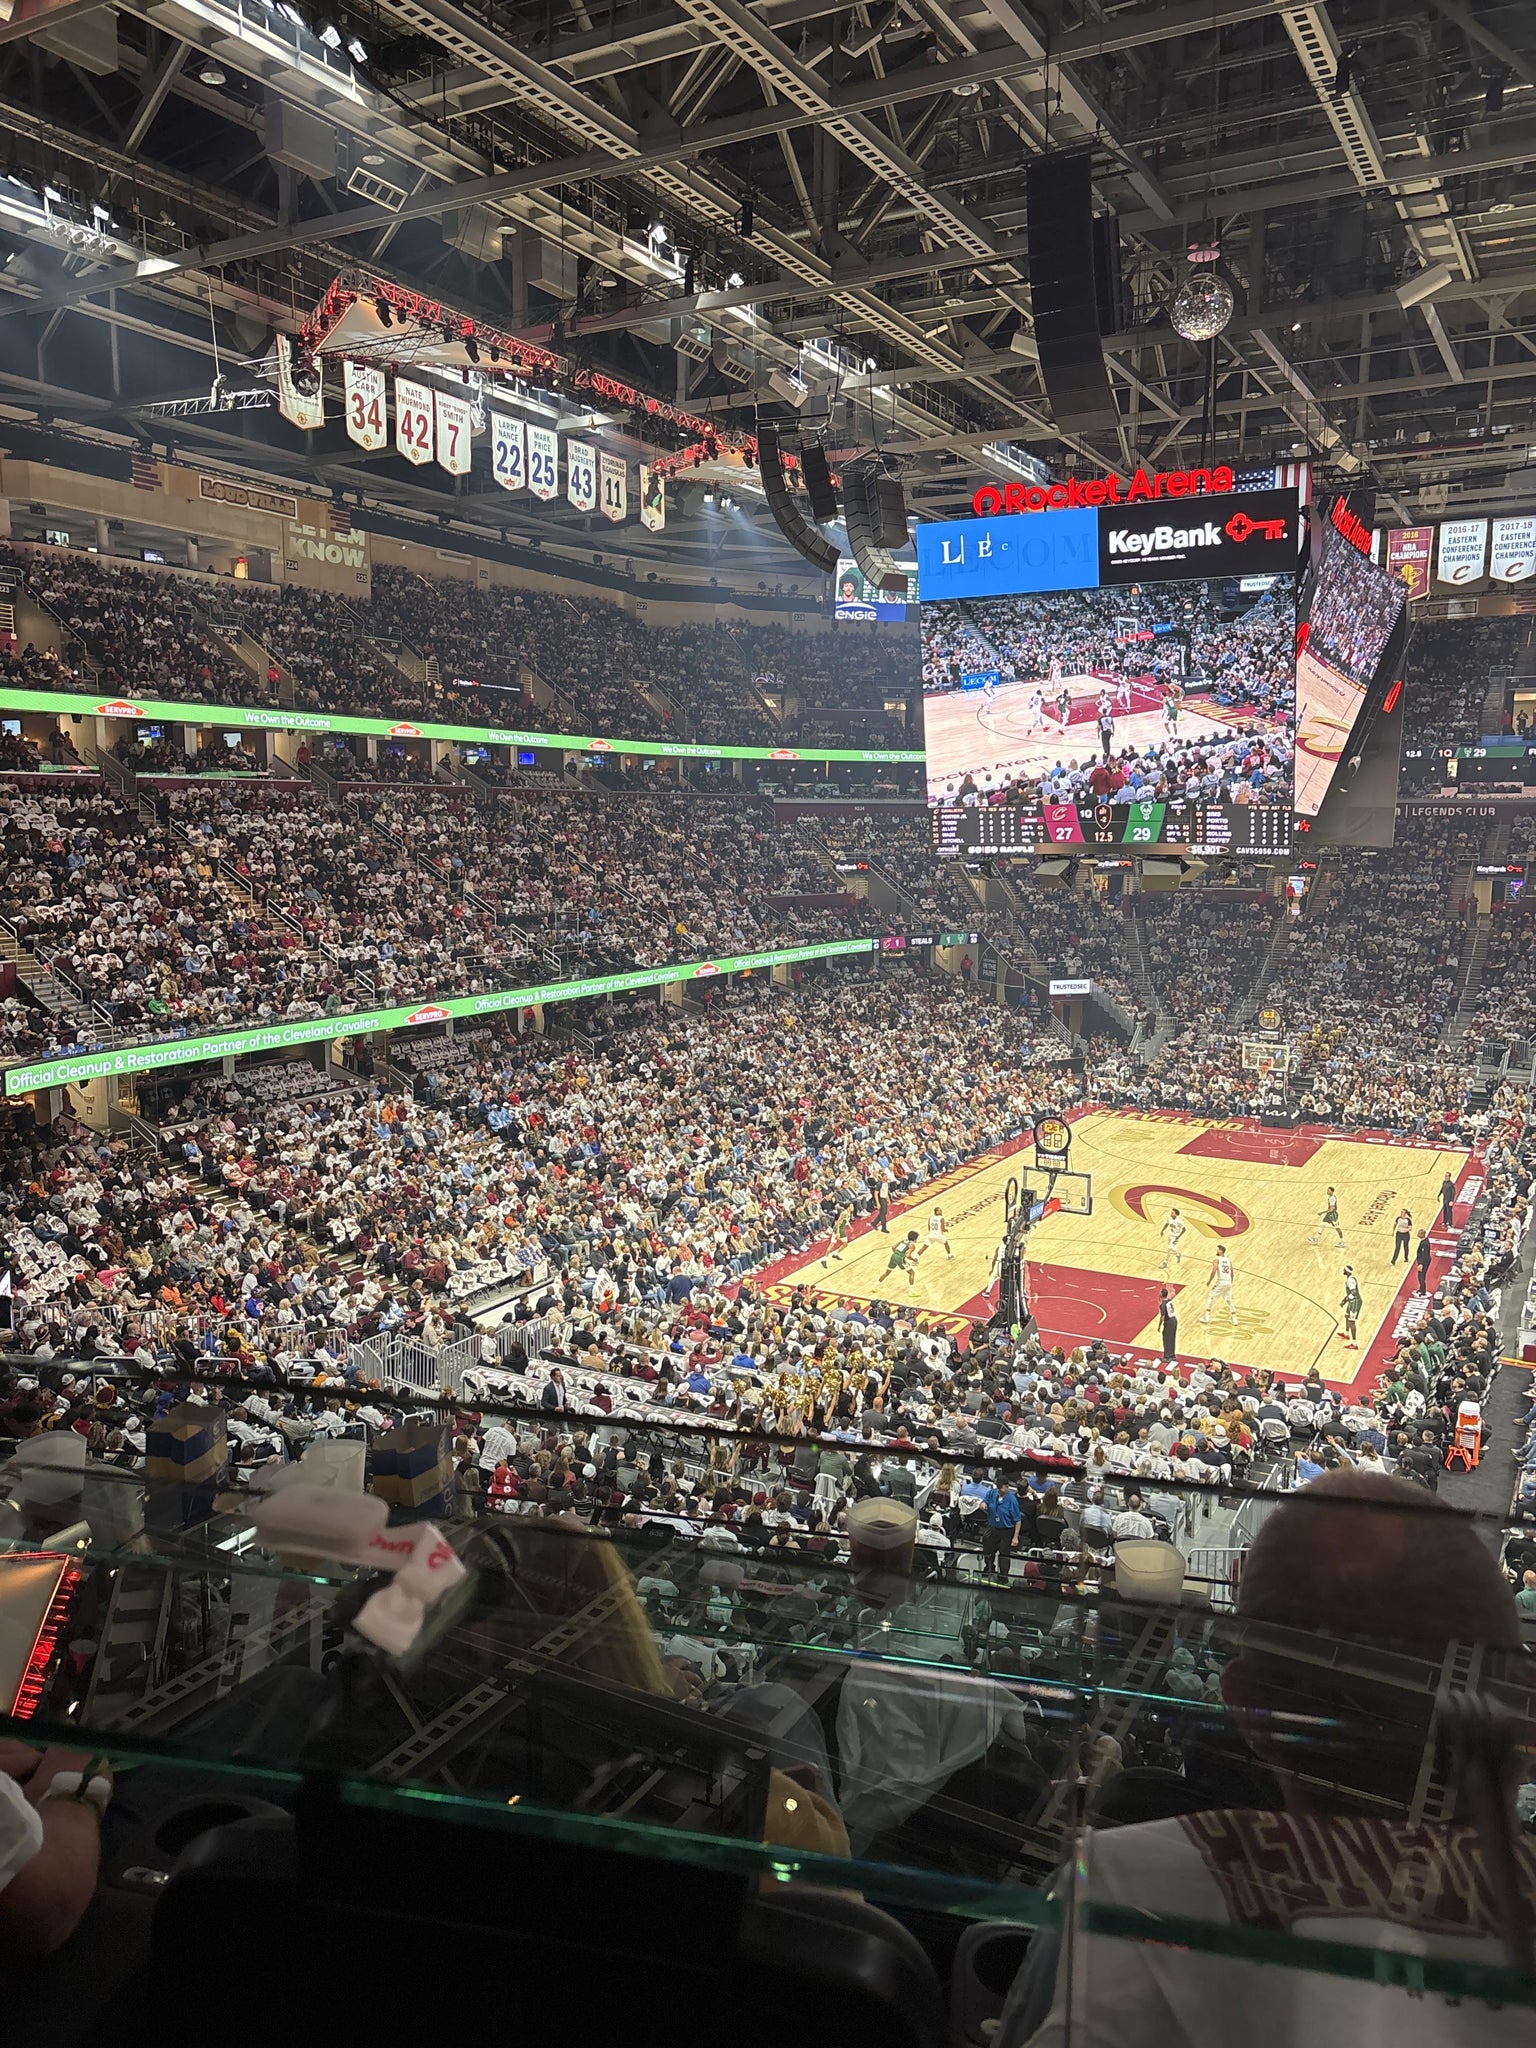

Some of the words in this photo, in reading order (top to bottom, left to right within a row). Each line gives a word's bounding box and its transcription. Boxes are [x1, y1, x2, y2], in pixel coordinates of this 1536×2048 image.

[352, 371, 378, 384] AUSTIN
[356, 380, 375, 394] CARR
[406, 387, 422, 399] NATE
[398, 394, 430, 412] THURMOND
[351, 393, 382, 434] 34
[443, 410, 463, 423] SMITH
[401, 410, 428, 449] 42
[498, 420, 518, 432] LARRY
[448, 424, 459, 457] 7
[498, 430, 518, 442] NANCE
[534, 431, 550, 443] MARK
[534, 442, 551, 453] PRICE
[574, 446, 588, 457] BRAD
[497, 441, 521, 477] 22
[532, 452, 554, 486] 25
[571, 466, 592, 498] 43
[606, 478, 621, 508] 11
[1005, 472, 1119, 513] Rocket
[1127, 465, 1233, 499] Arena
[203, 480, 294, 516] LOUDVILLE
[1448, 525, 1479, 534] 2016-17
[1500, 521, 1533, 531] 2017-18
[1109, 523, 1222, 555] KeyBank
[1402, 531, 1418, 539] 2016
[1448, 535, 1477, 544] EASTERN
[1500, 532, 1530, 541] EASTERN
[289, 536, 368, 569] KNOW.
[1403, 543, 1416, 551] NBA
[1442, 544, 1483, 554] CONFERENCE
[1391, 550, 1427, 560] CHAMPIONS
[1443, 553, 1480, 562] CHAMPIONS
[1495, 550, 1534, 560] CHAMPIONS
[105, 705, 137, 714] SERVPRO
[244, 712, 260, 722] We
[261, 713, 280, 724] Own
[281, 715, 294, 725] the
[295, 717, 330, 727] Outcome
[489, 732, 499, 740] We
[499, 733, 513, 742] Own
[514, 734, 523, 742] the
[524, 735, 548, 744] Outcome
[674, 746, 687, 754] Own
[1439, 749, 1453, 757] 1Q
[1473, 748, 1486, 757] 29
[927, 766, 991, 784] ocket
[995, 756, 1048, 769] Arena
[1080, 809, 1092, 818] 1Q
[1412, 807, 1462, 816] LEGENDS
[1055, 827, 1073, 840] 27
[1094, 832, 1113, 842] 12.5
[1133, 828, 1151, 840] 29
[911, 937, 933, 945] STEALS
[734, 960, 750, 968] Official
[848, 942, 871, 951] Cavaliers
[475, 998, 503, 1011] Official
[503, 992, 533, 1005] Cleanup
[534, 991, 540, 1000] &
[541, 986, 580, 1000] Restoration
[581, 982, 606, 993] Partner
[607, 980, 613, 989] of
[614, 978, 624, 988] the
[625, 974, 653, 986] Cleveland
[654, 971, 680, 982] Cavaliers
[9, 1071, 55, 1090] Official
[56, 1060, 112, 1080] Cleanup
[115, 1057, 125, 1069] &
[128, 1043, 200, 1066] Restoration
[203, 1038, 246, 1055] Partner
[249, 1034, 261, 1048] of
[263, 1031, 281, 1045] the
[283, 1023, 334, 1042] Cleveland
[335, 1017, 379, 1034] Cavaliers
[1092, 1110, 1245, 1130] CLEVELAND
[1222, 1265, 1229, 1274] 32
